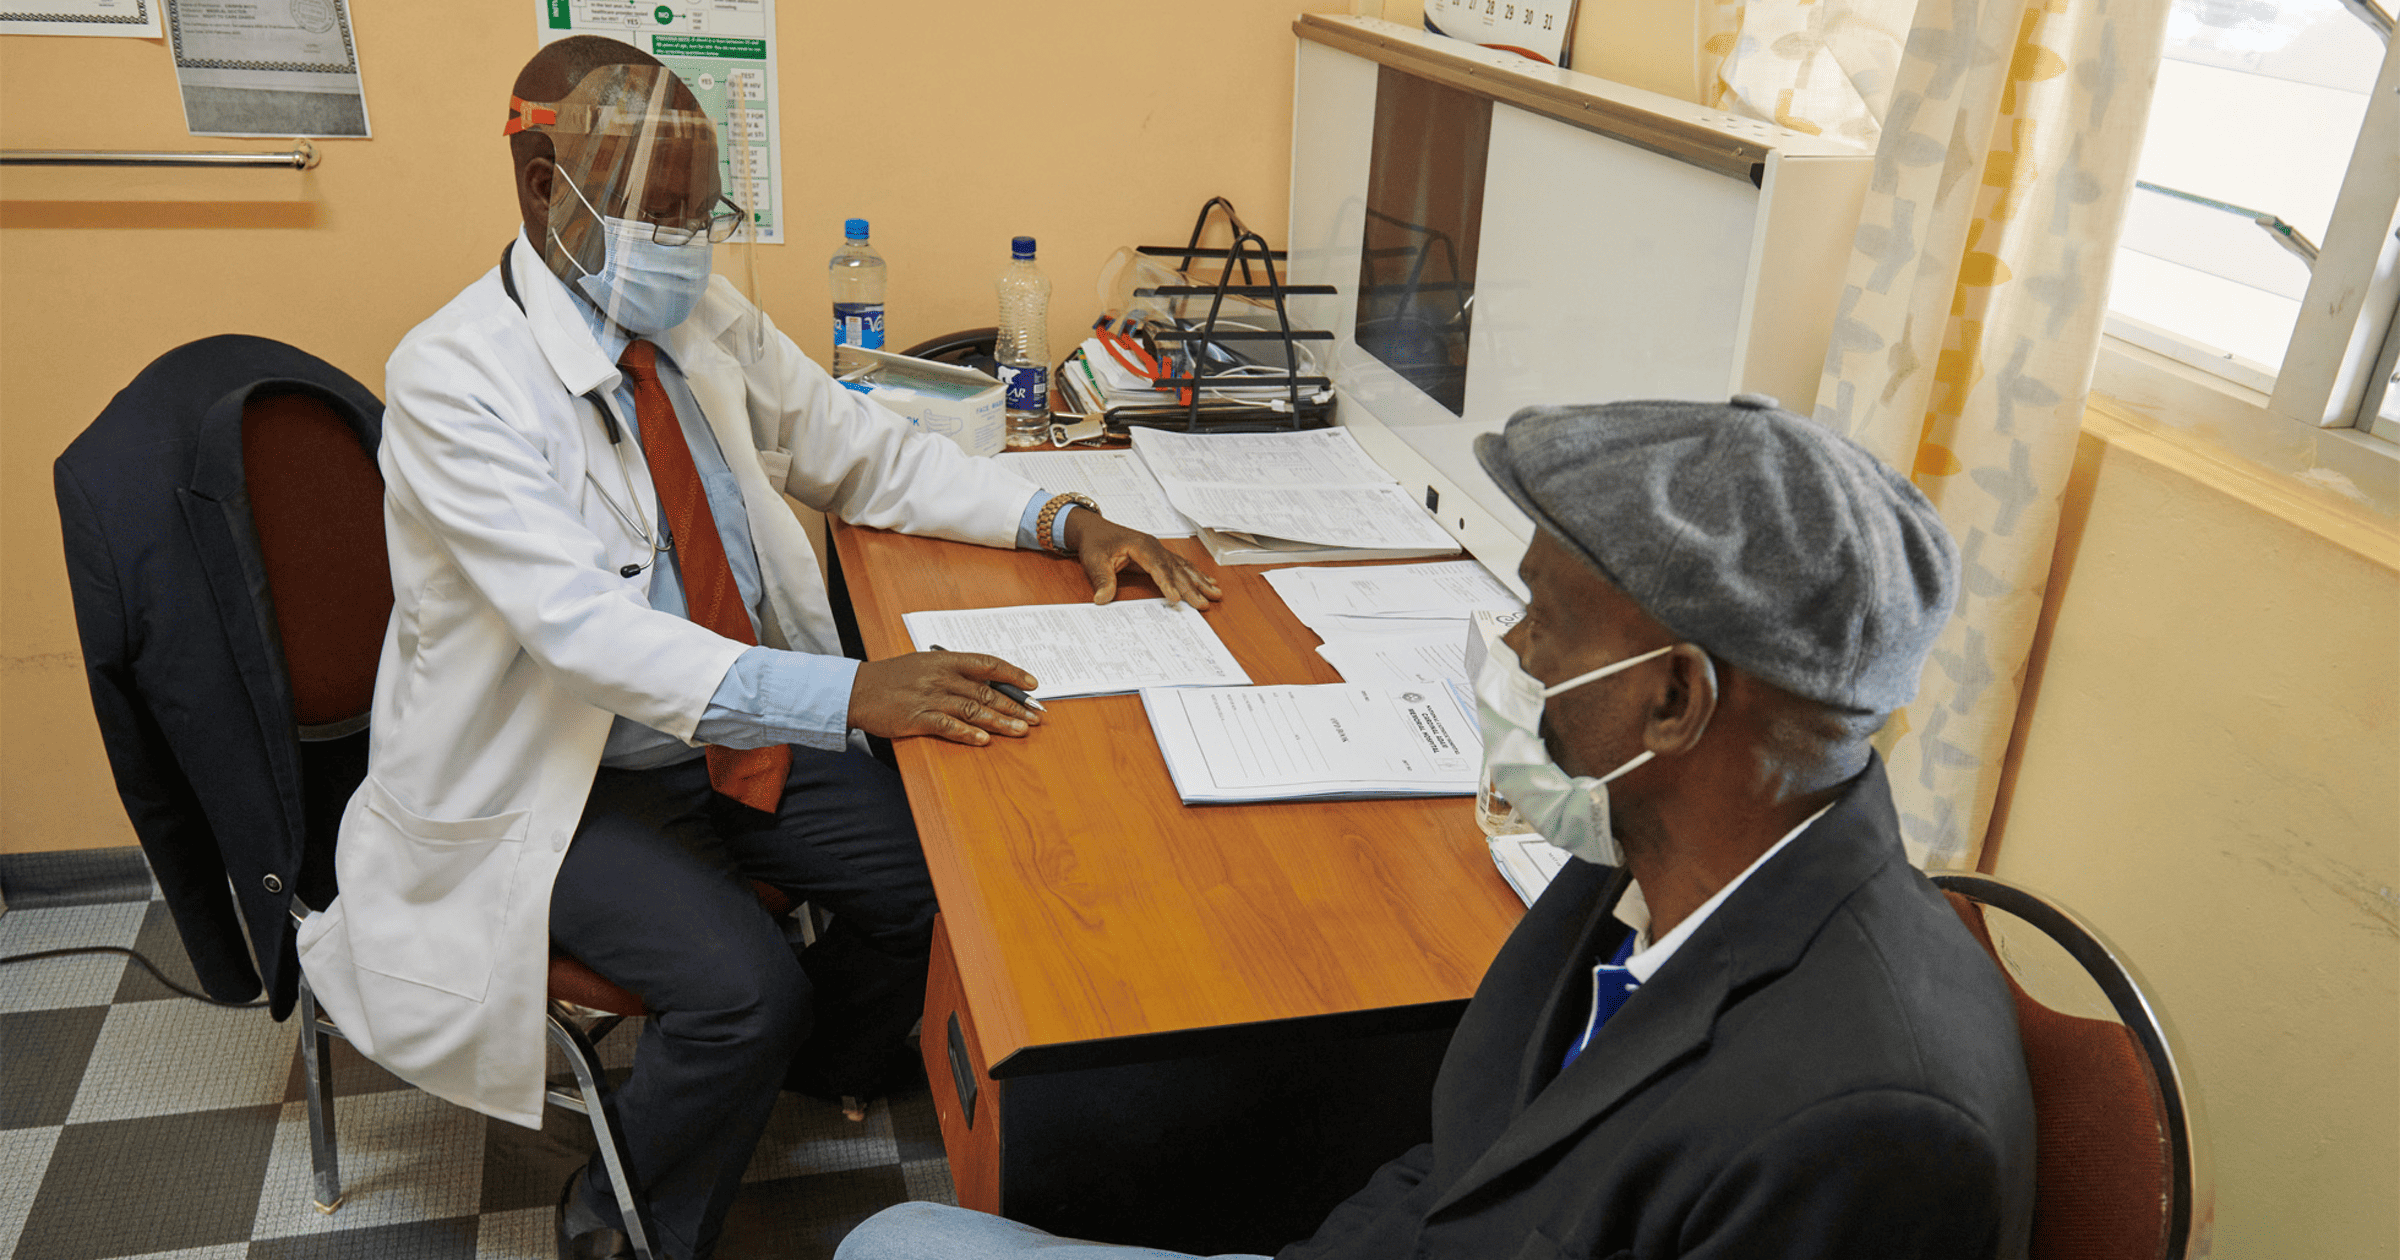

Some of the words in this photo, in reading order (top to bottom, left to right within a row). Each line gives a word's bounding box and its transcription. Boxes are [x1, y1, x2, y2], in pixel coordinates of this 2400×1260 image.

[1486, 0, 1495, 15] 28
[1505, 4, 1514, 20] 29
[1523, 9, 1533, 25] 30
[1543, 14, 1553, 30] 31
[1407, 708, 1426, 731] MEMORIAL
[1421, 731, 1440, 753] HOSPITAL
